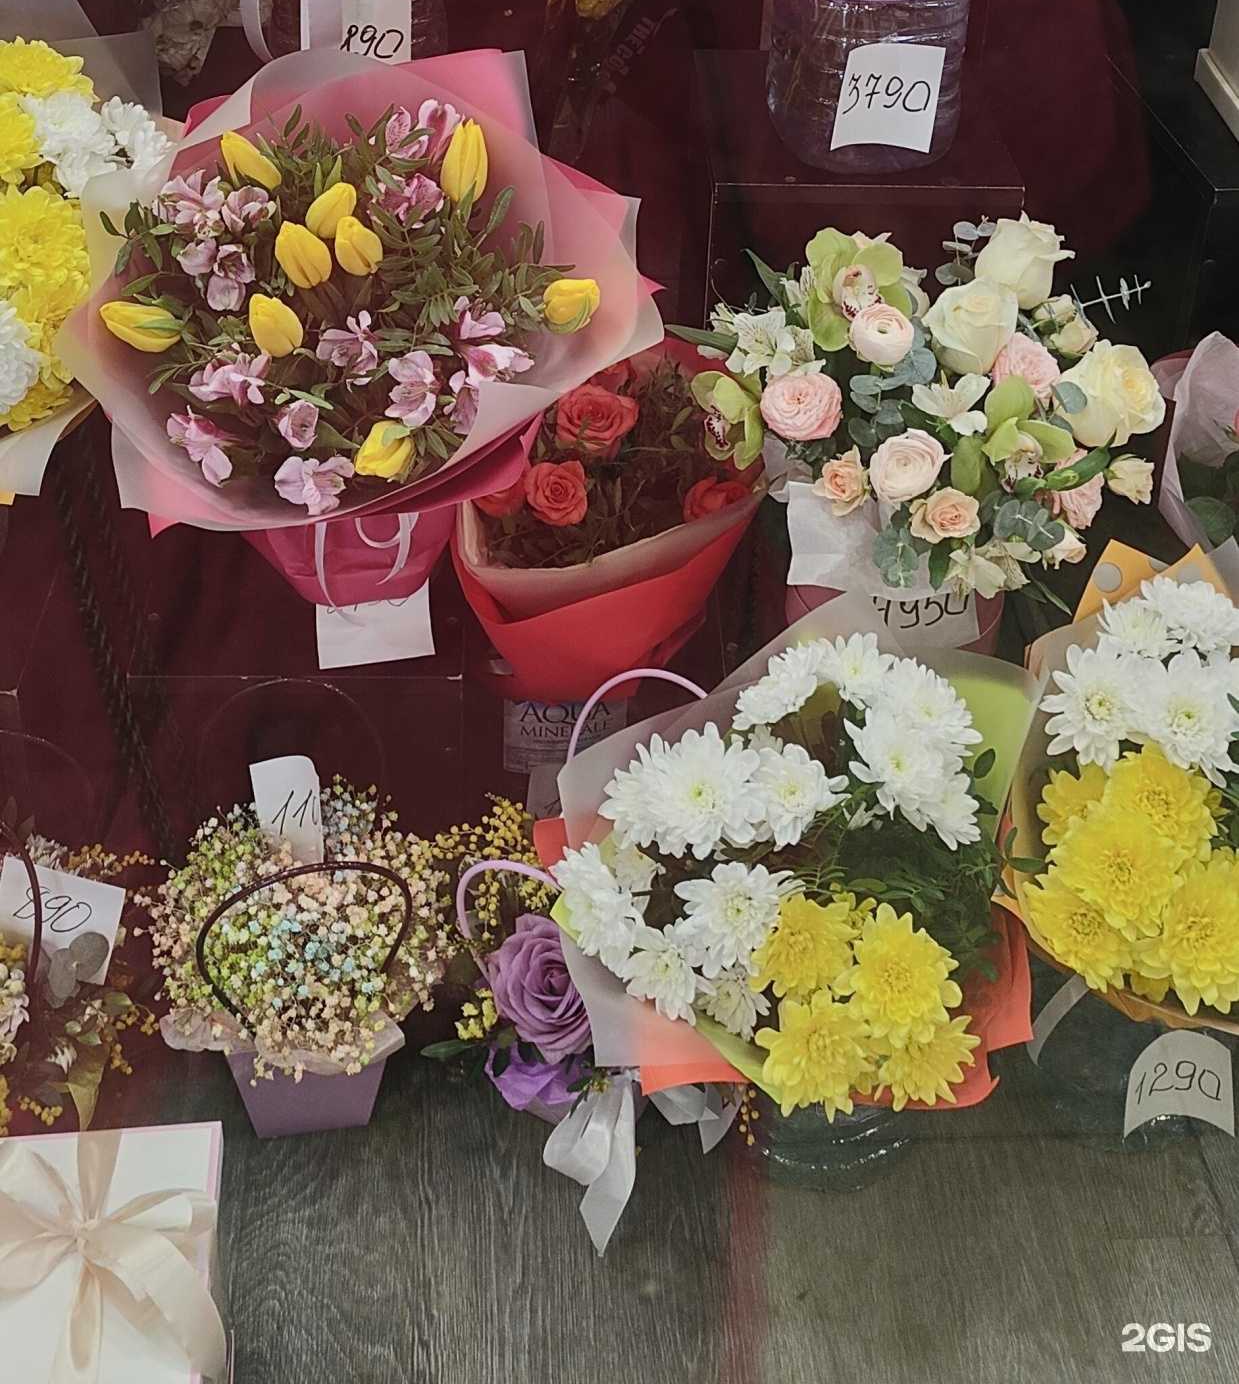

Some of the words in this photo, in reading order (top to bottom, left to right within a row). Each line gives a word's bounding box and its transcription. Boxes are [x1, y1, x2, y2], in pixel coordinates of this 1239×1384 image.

[841, 73, 931, 115] 3790
[519, 701, 611, 725] AQUA
[12, 886, 92, 933] 890
[1135, 1060, 1222, 1105] 1290
